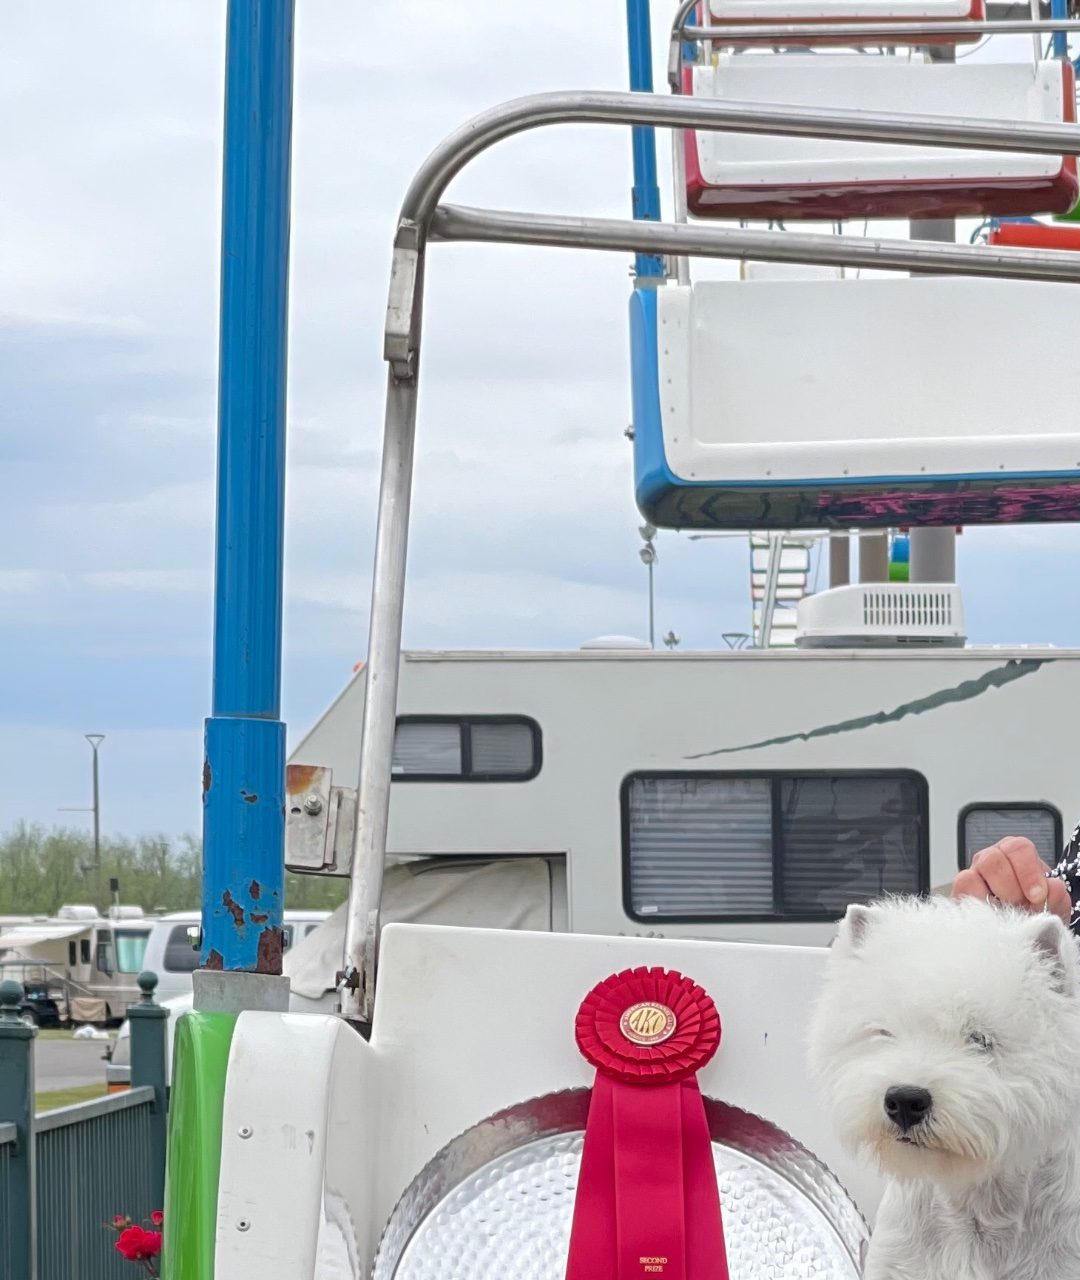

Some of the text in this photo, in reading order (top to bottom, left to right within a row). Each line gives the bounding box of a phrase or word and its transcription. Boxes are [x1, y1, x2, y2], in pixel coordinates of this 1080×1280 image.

[631, 1009, 664, 1035] AKC
[639, 1256, 668, 1264] SECOND
[644, 1265, 664, 1273] PRIZE
